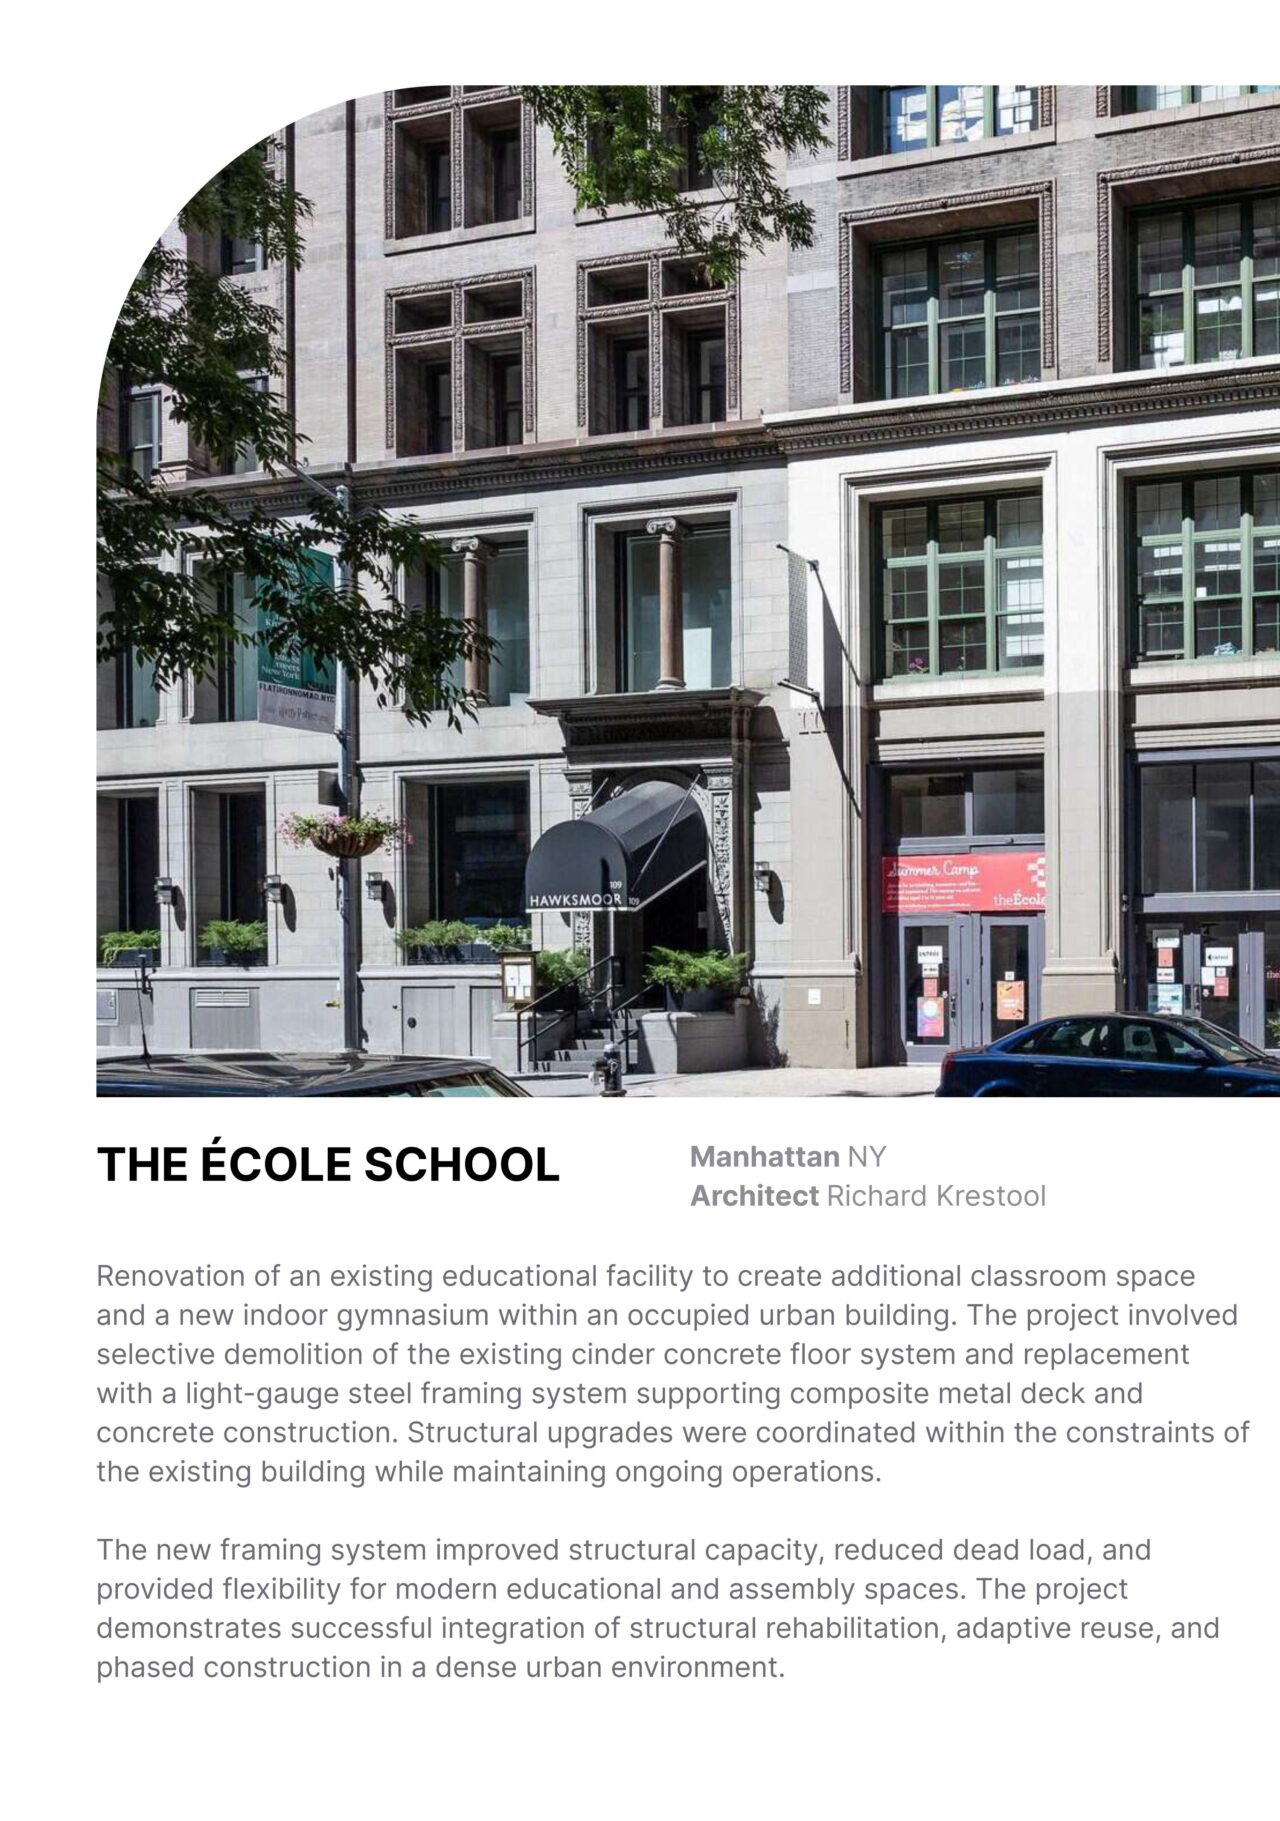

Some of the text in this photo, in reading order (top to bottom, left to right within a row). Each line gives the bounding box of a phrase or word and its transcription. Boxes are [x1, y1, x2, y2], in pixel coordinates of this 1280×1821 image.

[887, 860, 980, 880] Summer Camp
[609, 880, 622, 890] 109
[530, 893, 622, 907] HAWKSMOOR
[628, 897, 640, 906] 109
